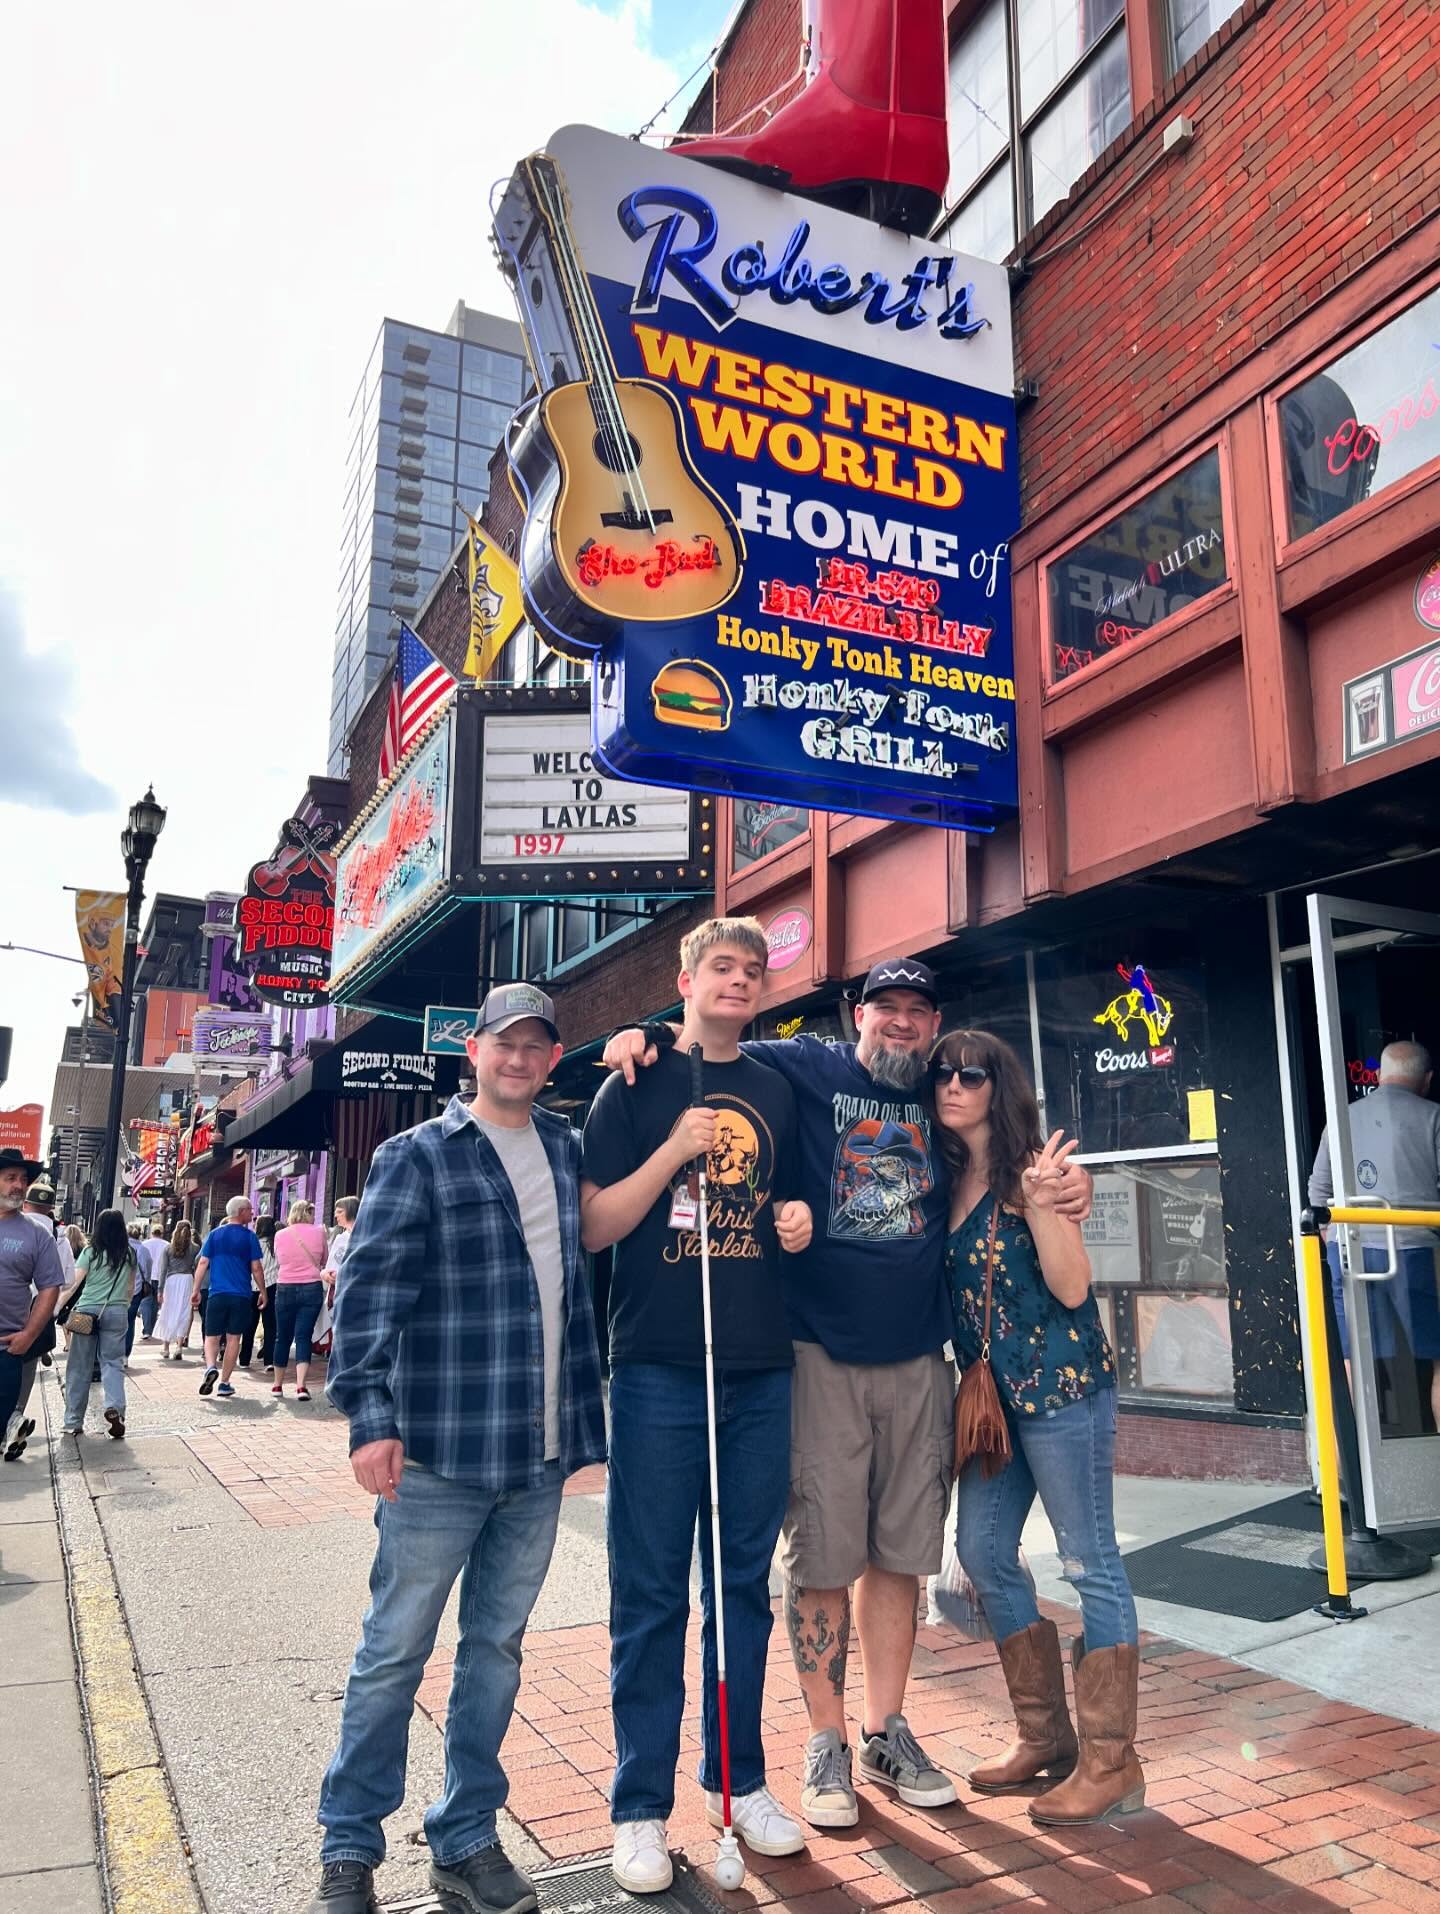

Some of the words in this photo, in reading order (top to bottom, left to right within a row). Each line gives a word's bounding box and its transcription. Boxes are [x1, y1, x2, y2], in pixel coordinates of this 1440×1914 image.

[617, 185, 992, 340] Robert's
[632, 321, 1007, 472] WESTERN
[688, 396, 964, 509] WORLD
[736, 482, 959, 579] HOME
[969, 543, 1009, 598] of
[1159, 527, 1221, 577] ULTRA
[716, 614, 820, 671] Honky
[826, 637, 903, 680] Tonk
[909, 653, 1016, 701] Heaven
[742, 674, 890, 726] Honky
[903, 688, 1010, 751] Tonk
[1409, 710, 1440, 728] DELICI
[533, 751, 592, 774] WELC
[800, 717, 958, 780] GRILL
[572, 779, 603, 801] TO
[542, 804, 637, 829] LAYLAS
[513, 833, 566, 857] 1997
[240, 896, 335, 930] SECO
[244, 924, 333, 953] FIDDL
[256, 974, 302, 990] HONKY
[308, 978, 328, 991] TO
[280, 961, 323, 977] MUSIC
[283, 990, 316, 1004] CITY
[342, 1051, 390, 1078] SECOND
[392, 1053, 436, 1082] FIDDLE
[1095, 1048, 1148, 1073] Coors
[1348, 1059, 1379, 1084] Coo
[343, 1080, 367, 1088] ROOFTOP
[708, 1199, 754, 1229] hris
